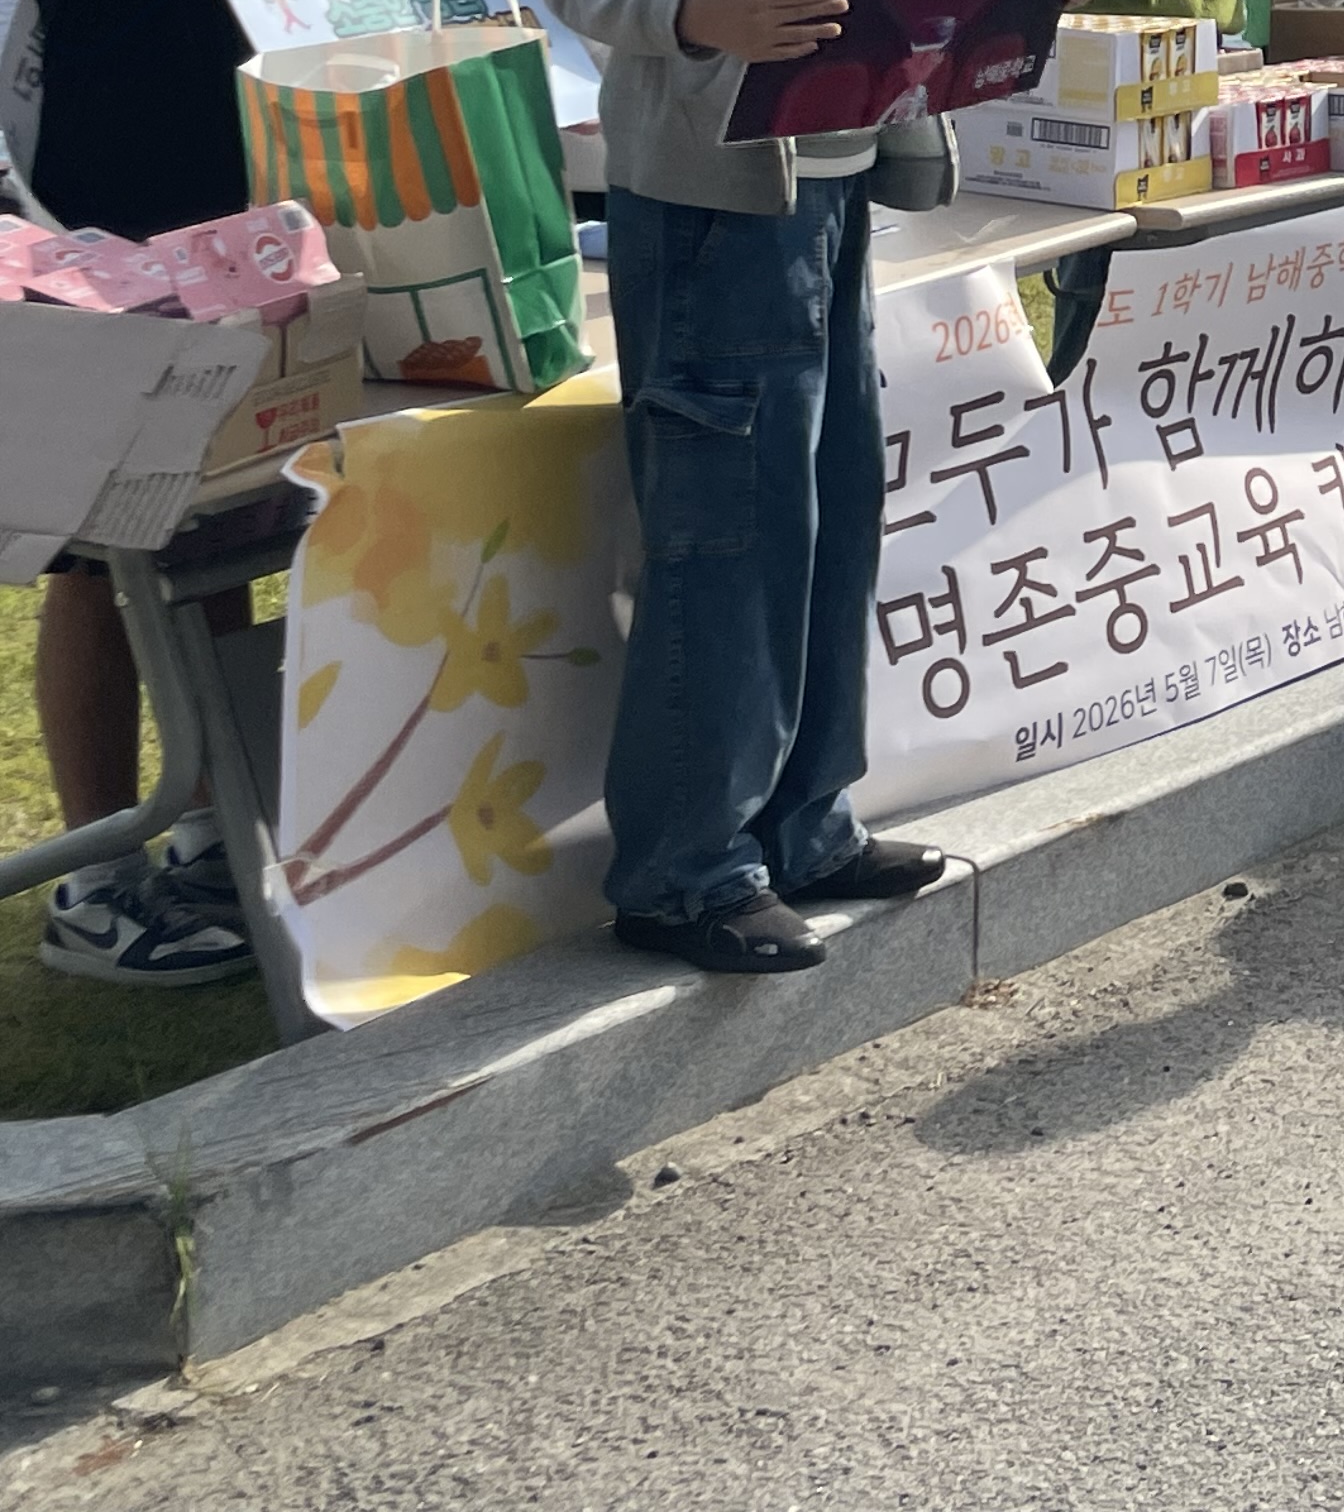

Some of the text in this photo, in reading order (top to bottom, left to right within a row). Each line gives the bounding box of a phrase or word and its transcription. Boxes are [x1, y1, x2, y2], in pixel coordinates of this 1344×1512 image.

[1282, 147, 1307, 164] 사과
[1151, 262, 1234, 318] 1학기
[1014, 711, 1064, 763] 일시
[1071, 678, 1159, 740] 2026년
[1163, 660, 1202, 705] 5월
[1205, 632, 1273, 691] 7일(목)
[1281, 620, 1323, 659] 장소
